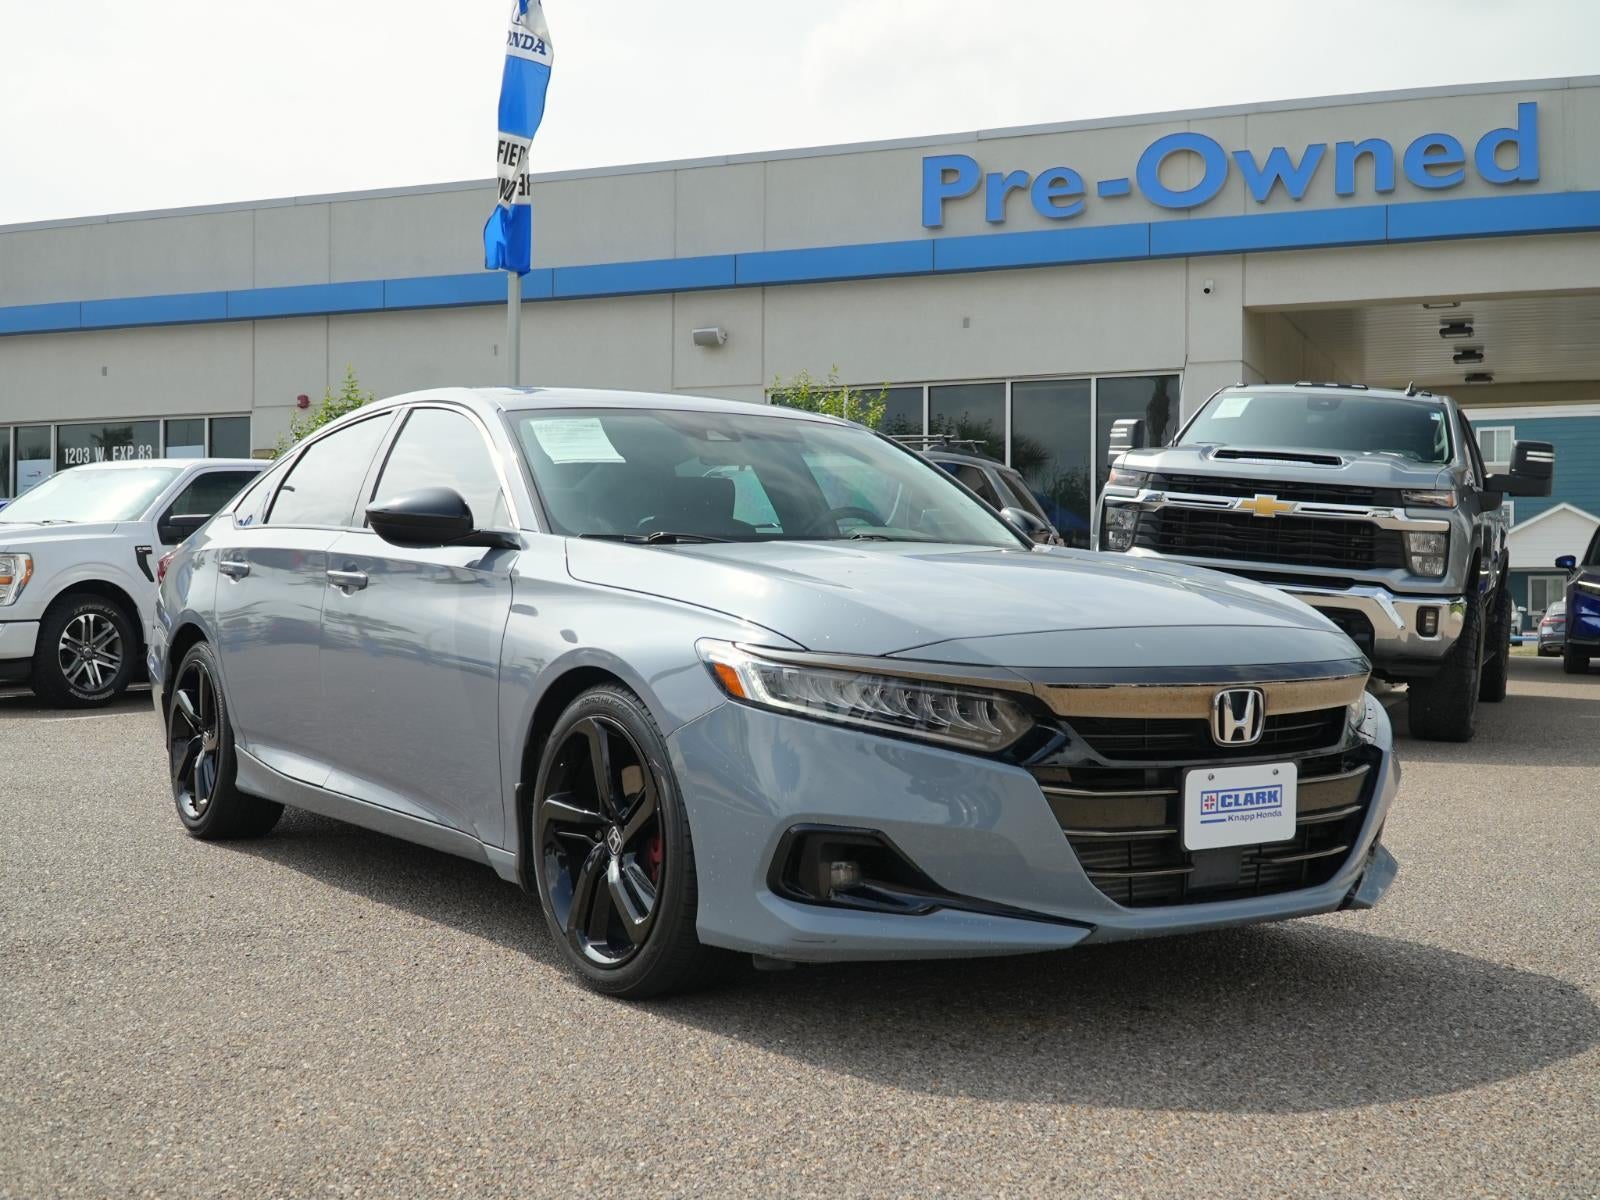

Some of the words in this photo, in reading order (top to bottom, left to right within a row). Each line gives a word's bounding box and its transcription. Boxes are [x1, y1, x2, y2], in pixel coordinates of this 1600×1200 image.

[922, 102, 1539, 229] Pre-Owned
[65, 448, 89, 464] 1203
[138, 445, 152, 460] 83
[1220, 790, 1279, 808] CLARK
[1227, 815, 1255, 823] Knapp
[1256, 810, 1282, 818] Honda
